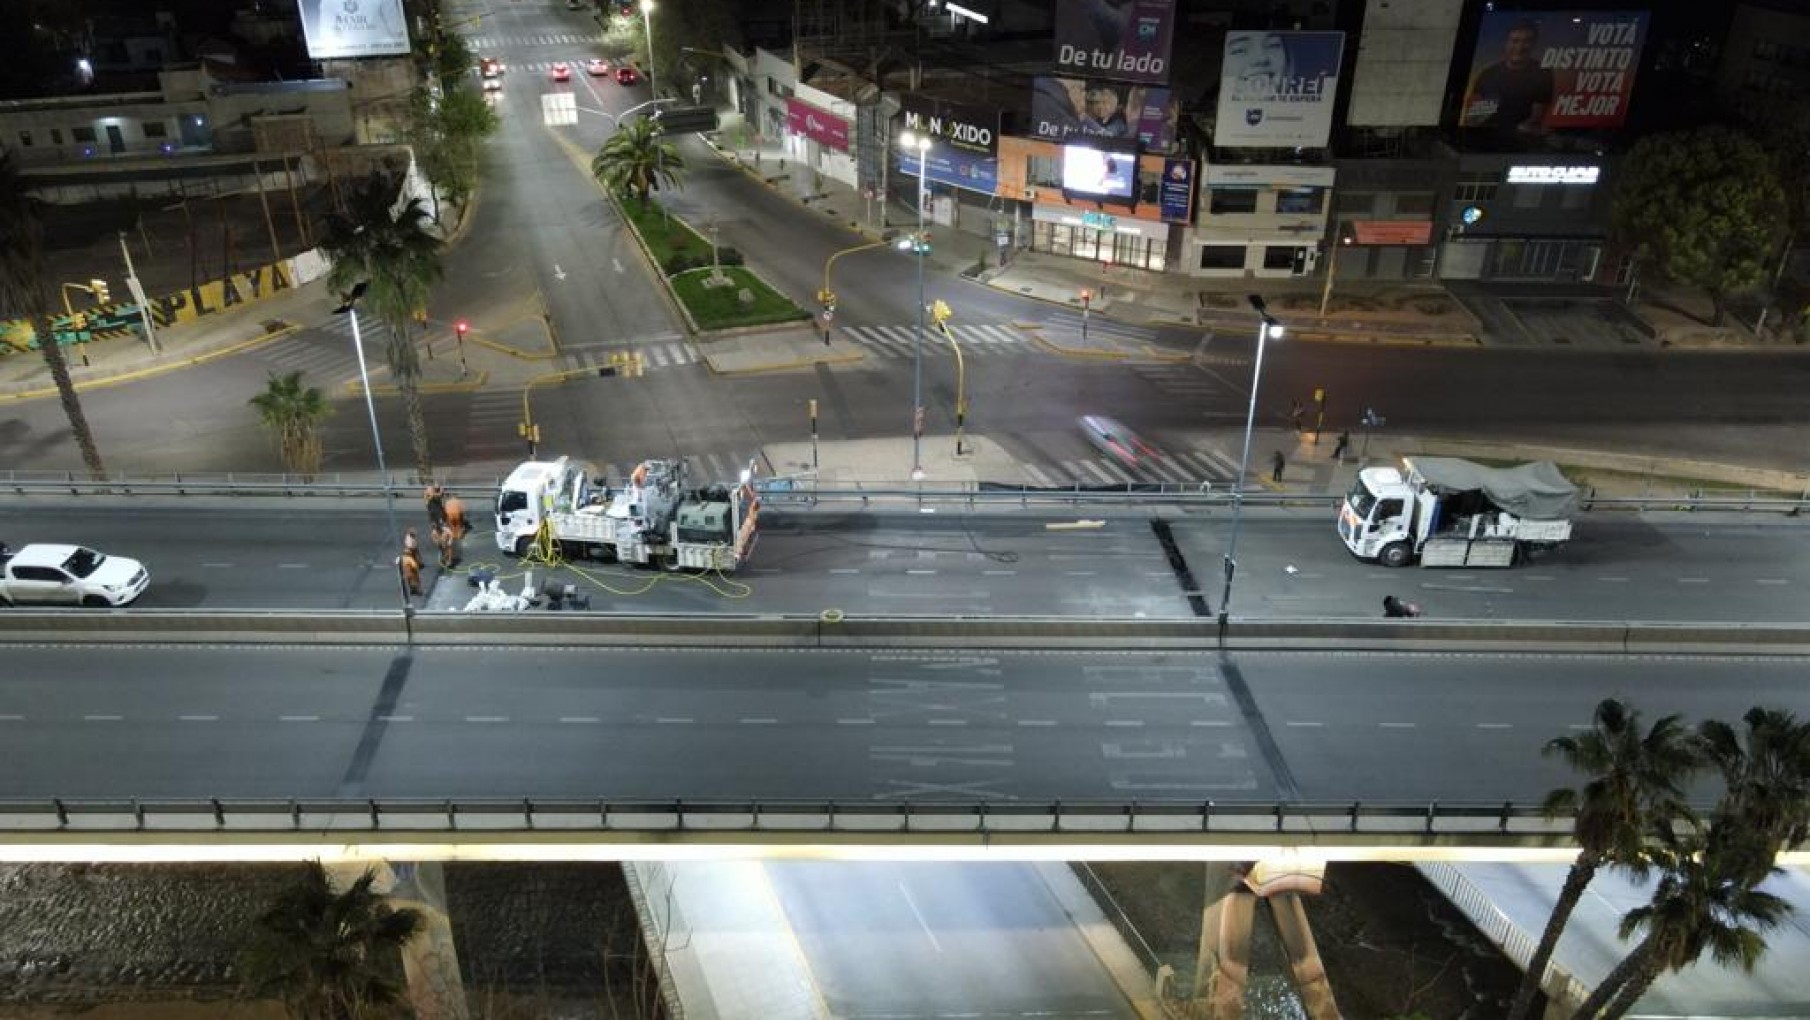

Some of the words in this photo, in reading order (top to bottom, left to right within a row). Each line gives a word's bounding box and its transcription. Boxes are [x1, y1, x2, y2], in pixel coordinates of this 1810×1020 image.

[1059, 43, 1087, 66] De
[1091, 48, 1113, 69] tu
[1116, 48, 1164, 73] lado
[1540, 46, 1633, 70] DISTINTO
[1551, 94, 1620, 116] MEJOR
[1038, 121, 1058, 137] De
[167, 260, 291, 327] PLAYA
